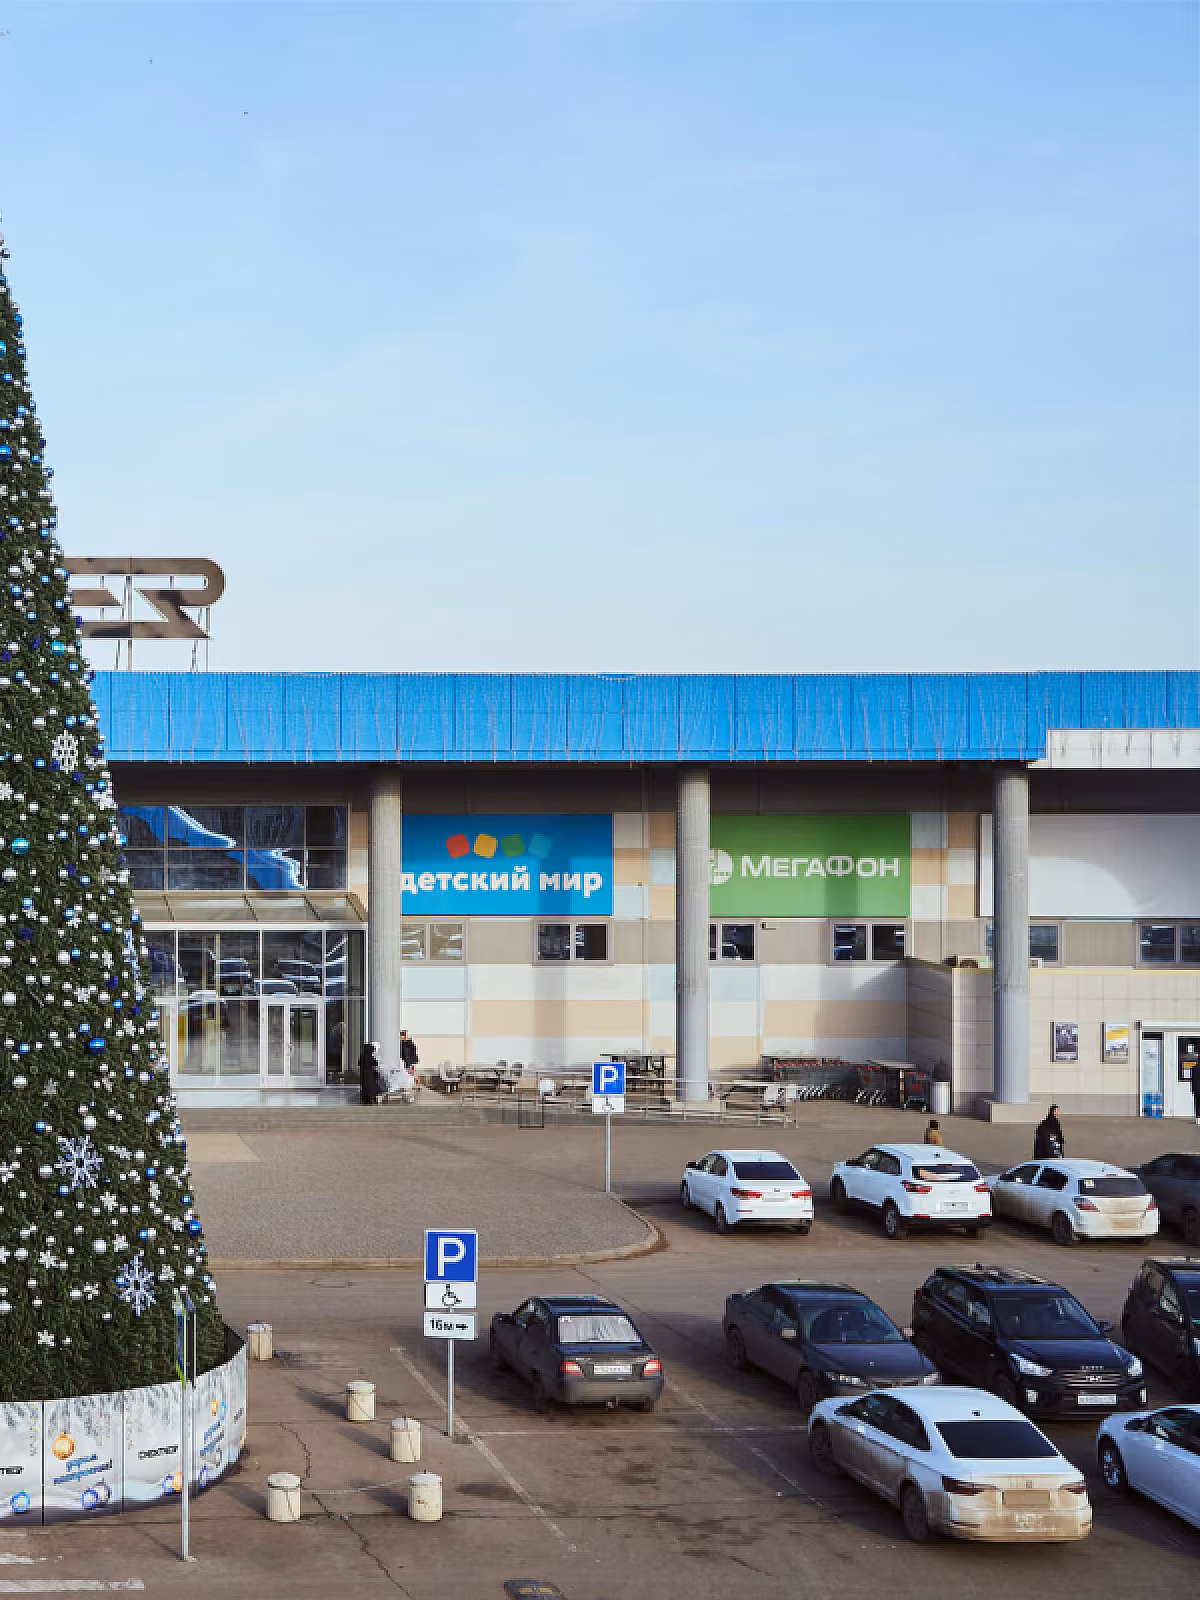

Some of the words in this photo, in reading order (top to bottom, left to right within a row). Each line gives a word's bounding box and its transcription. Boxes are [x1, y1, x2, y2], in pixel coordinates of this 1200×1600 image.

[400, 864, 531, 895] детский
[539, 871, 603, 899] мир
[601, 1065, 618, 1091] P
[437, 1236, 467, 1277] P
